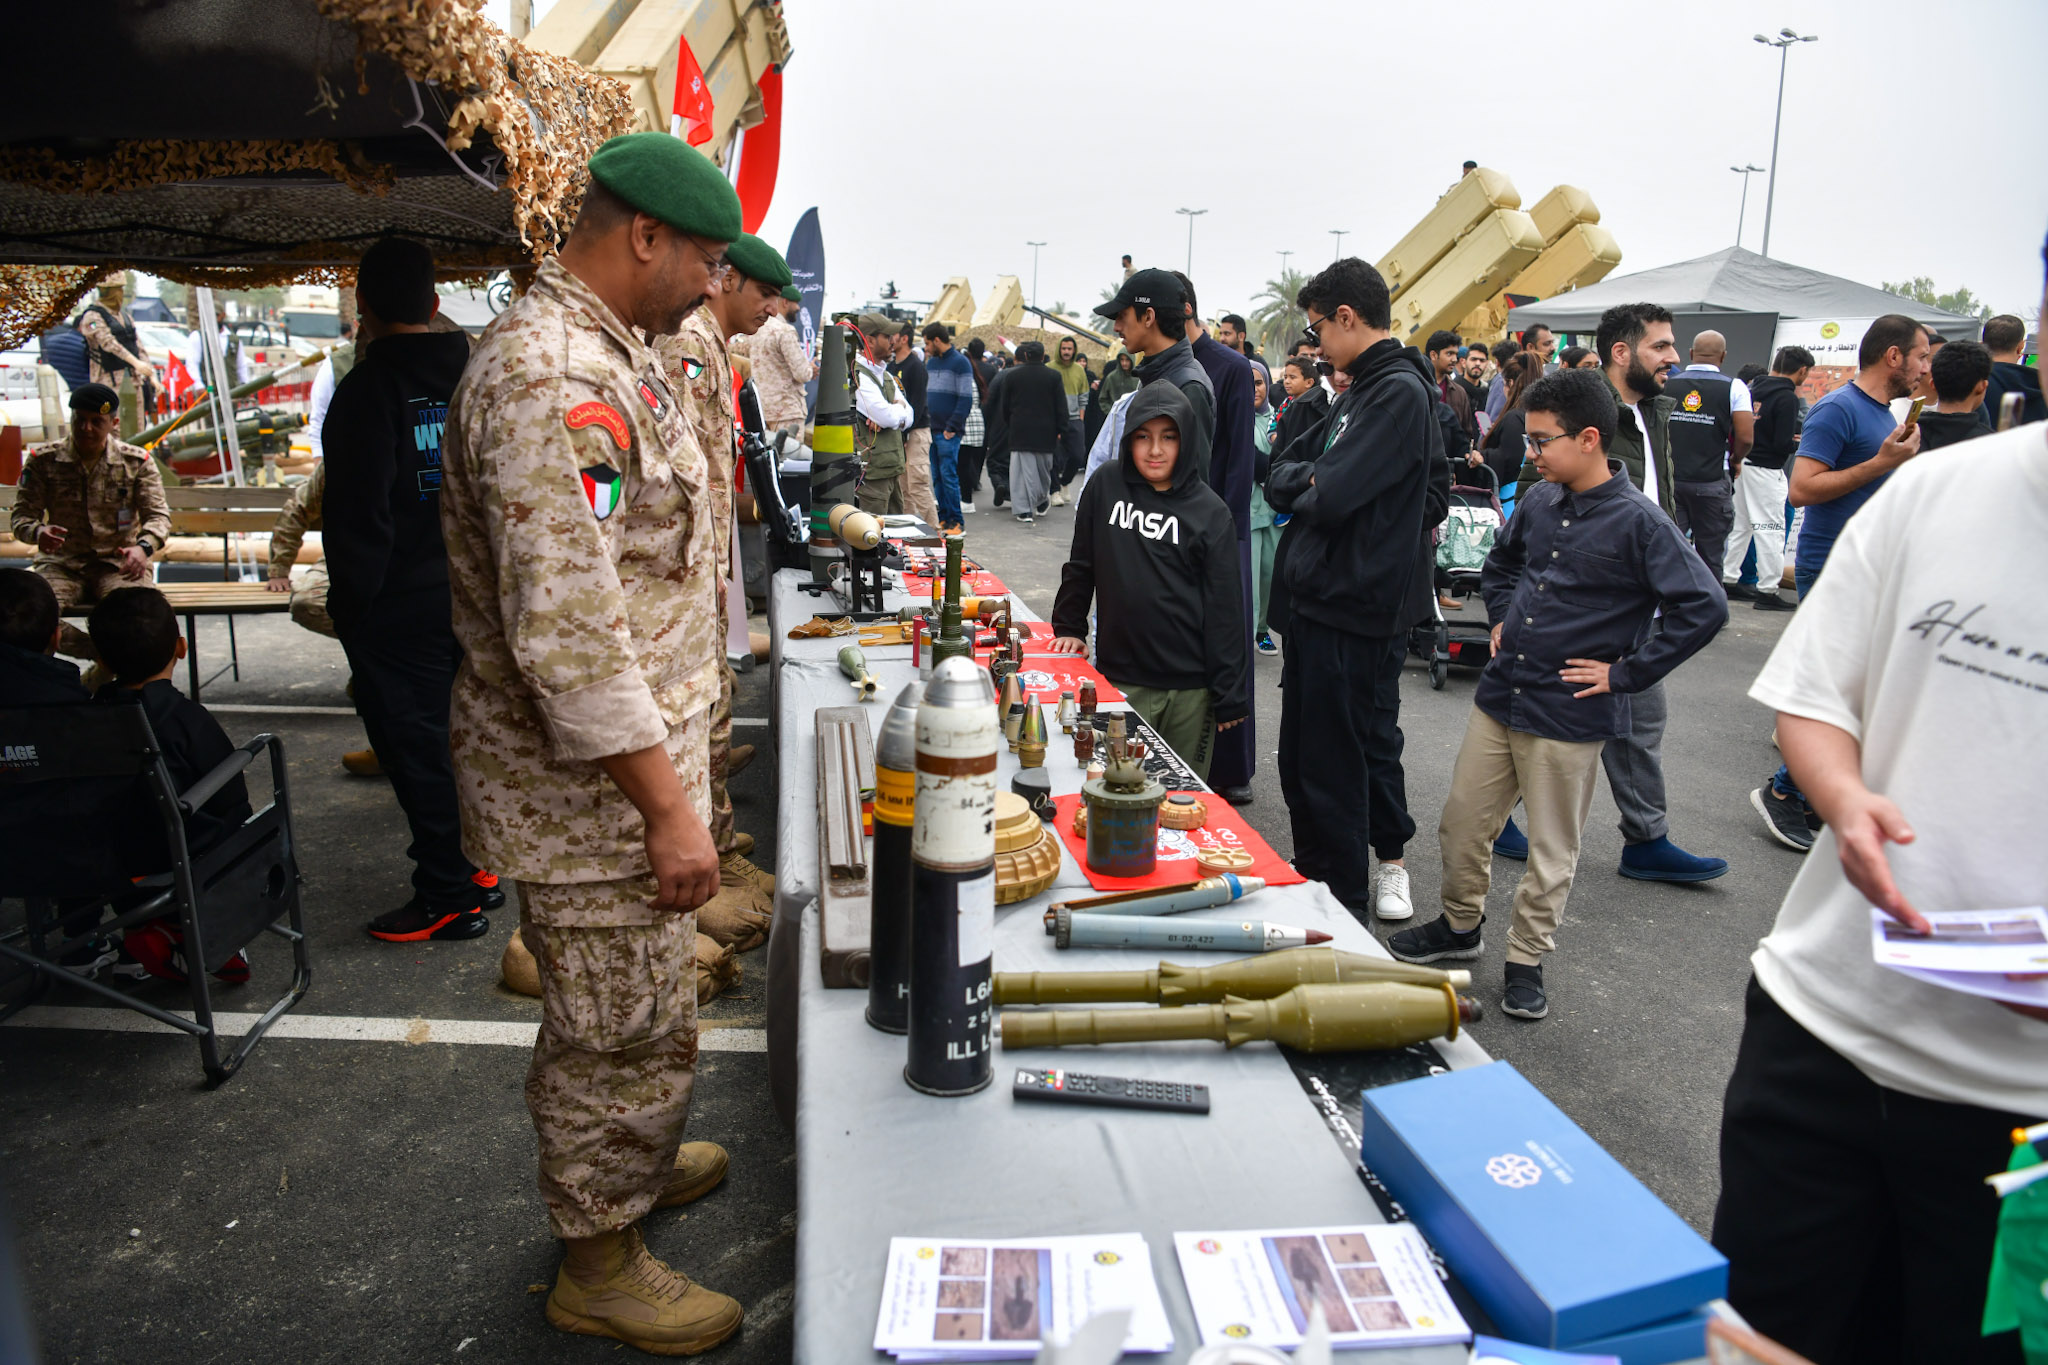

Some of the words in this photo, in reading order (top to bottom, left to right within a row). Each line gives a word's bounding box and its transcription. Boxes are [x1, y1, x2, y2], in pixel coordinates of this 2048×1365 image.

[1108, 500, 1179, 545] NASA
[967, 1015, 977, 1029] Z
[947, 1040, 977, 1061] ILL
